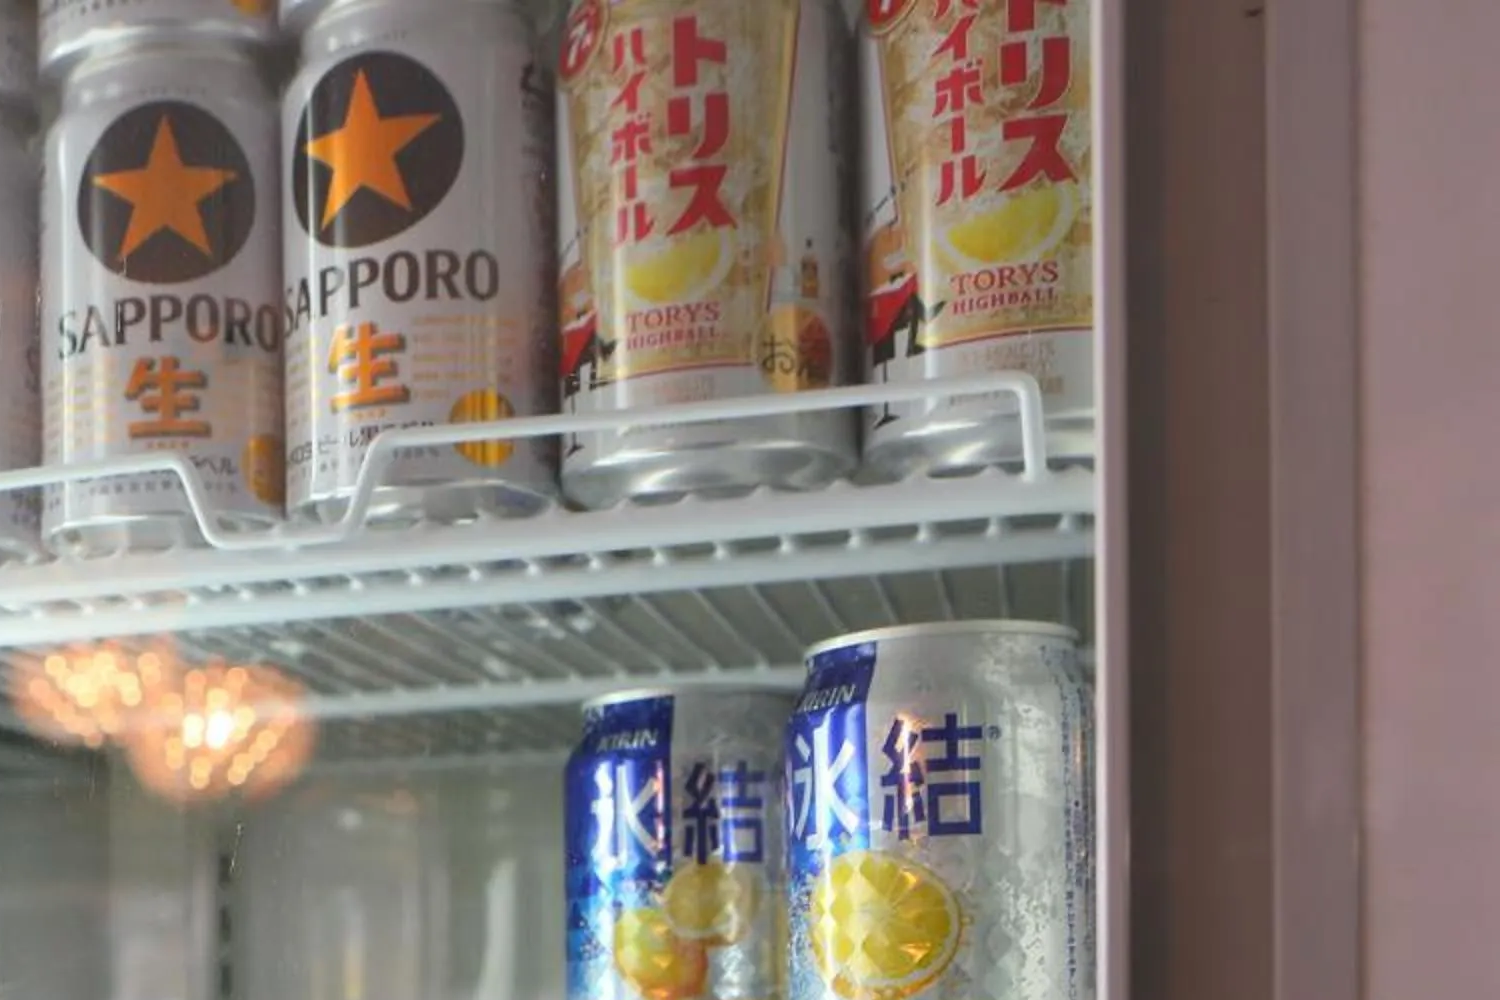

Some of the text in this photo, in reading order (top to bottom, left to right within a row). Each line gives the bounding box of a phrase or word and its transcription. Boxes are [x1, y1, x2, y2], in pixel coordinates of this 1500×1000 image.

[609, 27, 658, 249] ハイボール
[666, 15, 738, 238] トリス
[625, 301, 721, 332] TORYS
[950, 259, 1060, 295] TORYS
[952, 286, 1057, 315] HIGHBALL
[57, 292, 281, 361] SAPPORO
[327, 320, 411, 415] 生
[625, 324, 720, 351] HIGHBALL
[123, 355, 212, 439] 生
[591, 758, 767, 872] 氷結
[791, 711, 984, 852] 氷結
